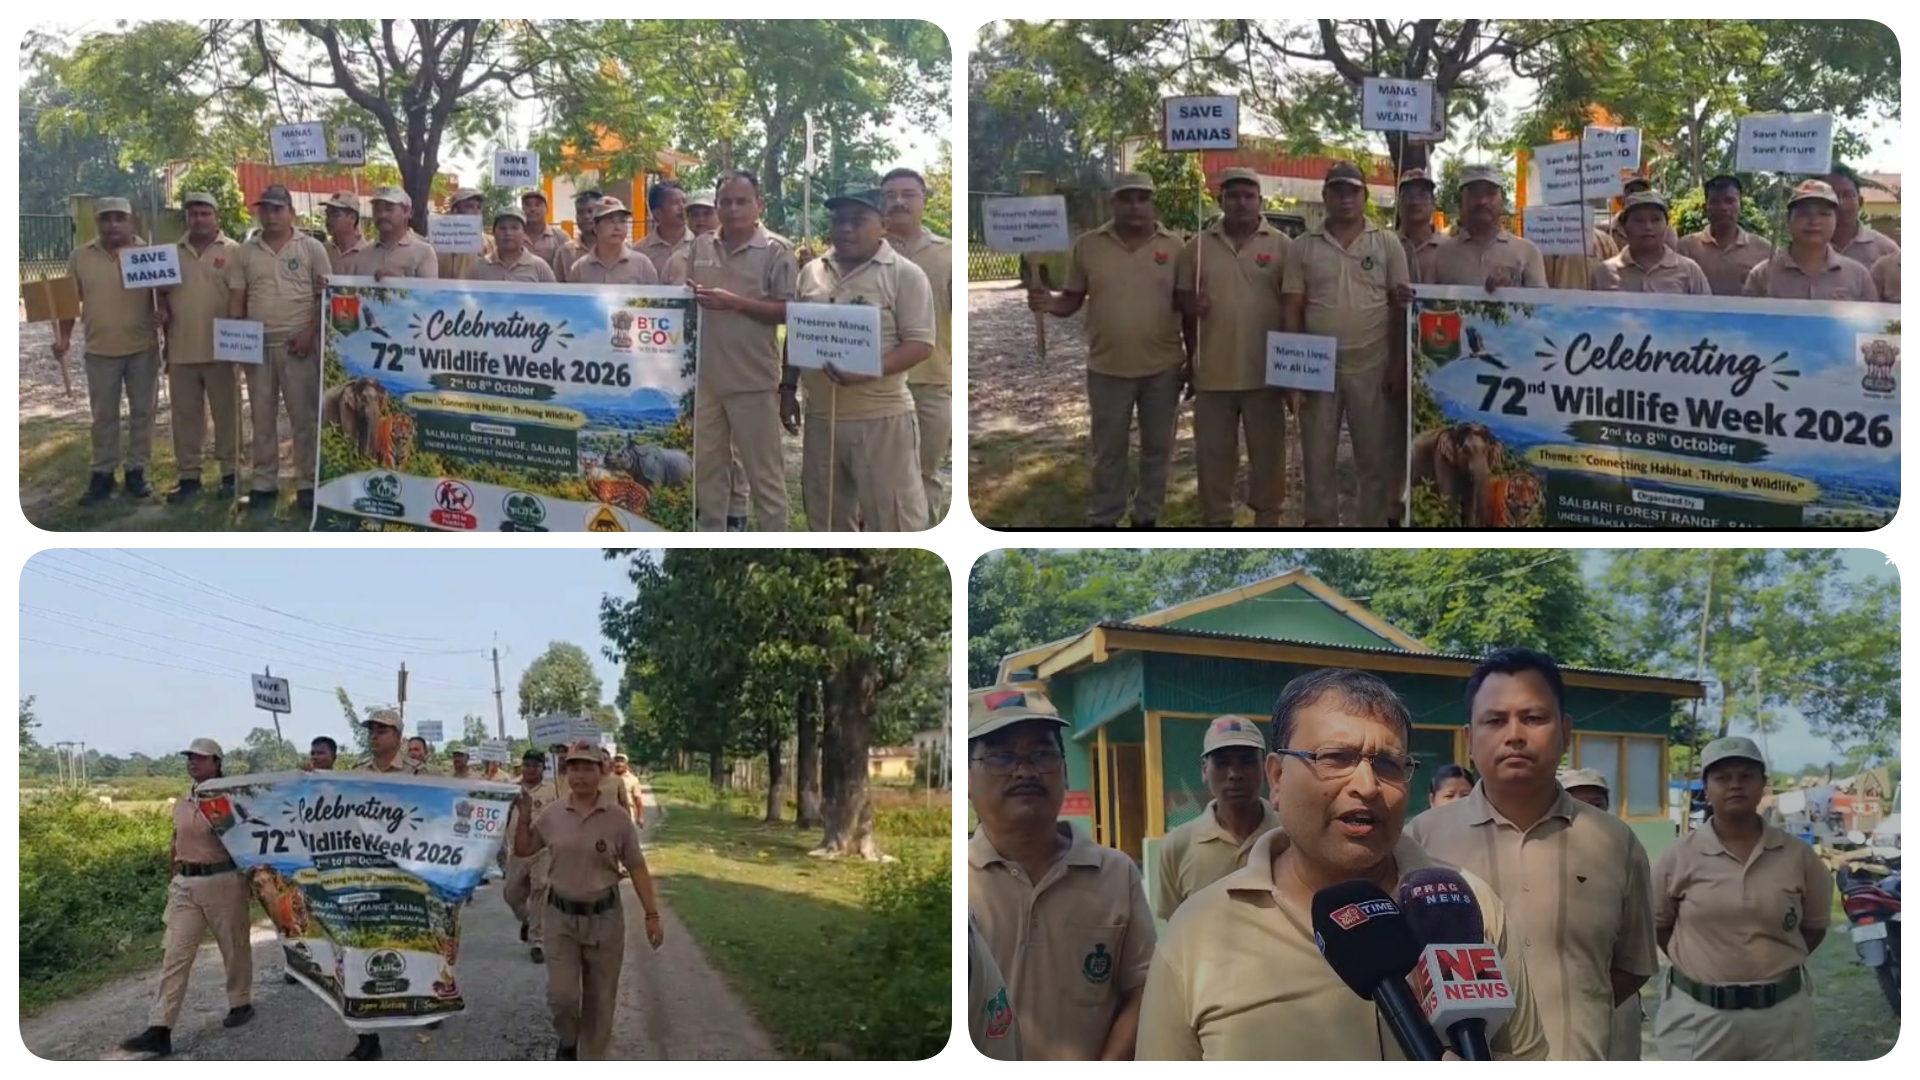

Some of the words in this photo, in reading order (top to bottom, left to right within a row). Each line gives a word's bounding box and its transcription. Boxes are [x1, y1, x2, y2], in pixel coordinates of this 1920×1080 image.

[1379, 84, 1417, 96] MANAS
[1179, 105, 1222, 118] SAVE
[1376, 111, 1418, 122] WEALTH
[281, 129, 312, 138] MANAS
[1172, 127, 1231, 141] MANAS
[1753, 129, 1777, 139] Save
[1780, 129, 1818, 138] Nature
[1595, 150, 1612, 158] Save
[1752, 145, 1777, 154] Save
[1780, 145, 1816, 154] Future
[504, 156, 528, 165] SAVE
[500, 169, 530, 178] RHINO
[131, 251, 167, 264] SAVE
[127, 268, 176, 282] MANAS
[638, 316, 670, 330] BTC
[427, 309, 553, 353] Celebrating
[638, 330, 680, 346] GOV
[796, 332, 828, 343] Protect
[831, 335, 870, 347] Nature's
[419, 347, 499, 375] Wildlife
[503, 355, 566, 382] Week
[571, 360, 632, 388] 2026
[1565, 332, 1767, 397] Celebrating
[466, 380, 477, 389] to
[494, 383, 535, 396] October
[1551, 384, 1679, 424] Wildlife
[1686, 397, 1787, 437] Week
[1795, 407, 1893, 448] 2026
[425, 428, 459, 441] SALBARI
[461, 434, 493, 445] FOREST
[531, 443, 571, 456] SALBARI
[1600, 426, 1622, 440] 2nd
[1626, 434, 1642, 444] to
[1646, 431, 1667, 446] 8th
[1670, 434, 1736, 456] October
[1540, 450, 1573, 463] Theme
[1581, 454, 1647, 474] "Connecting
[1650, 463, 1692, 478] Habitat
[1751, 477, 1804, 493] Wildlife"
[1558, 496, 1612, 512] SALBARI
[1616, 504, 1667, 520] FOREST
[1557, 511, 1589, 523] UNDER
[476, 806, 500, 820] BTC
[415, 841, 464, 865] 2026
[1412, 883, 1458, 897] PRAG
[1426, 894, 1471, 905] NEWS
[1361, 902, 1395, 914] TIME
[1435, 949, 1503, 981] NE
[1443, 982, 1509, 1000] NEWS
